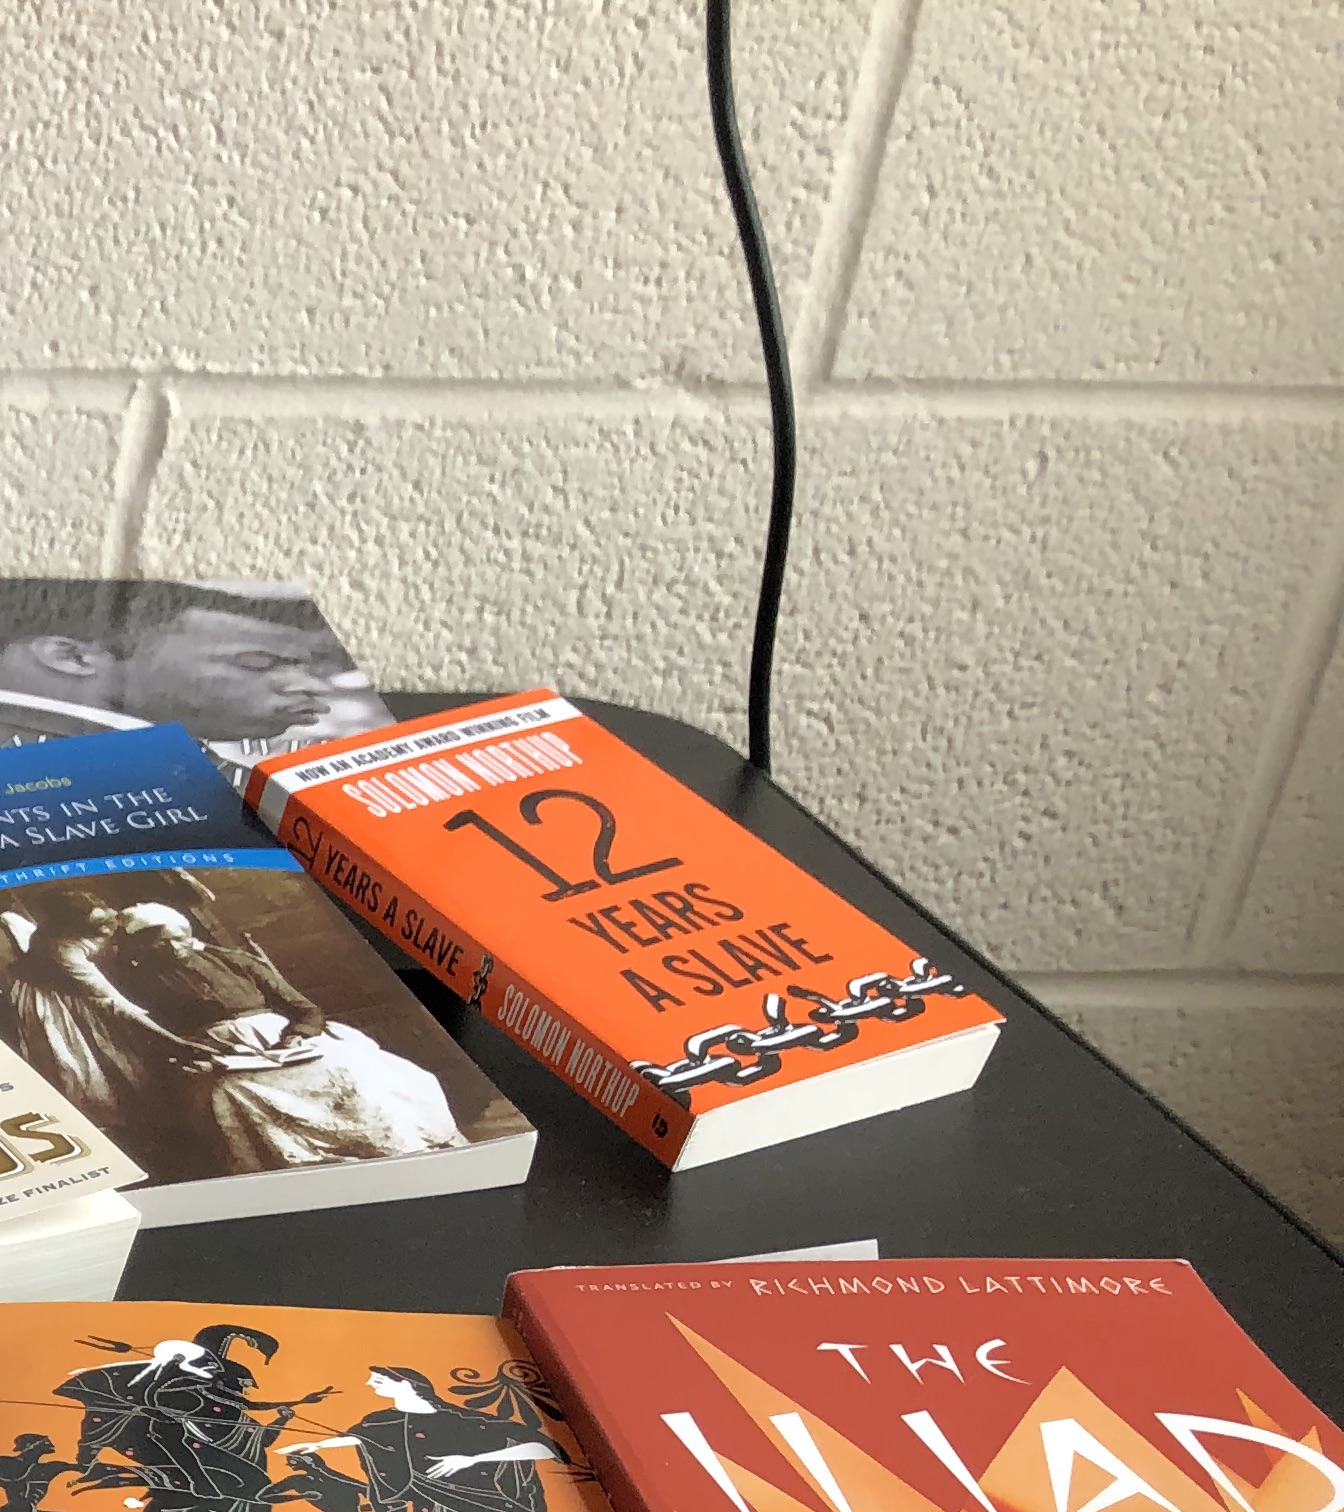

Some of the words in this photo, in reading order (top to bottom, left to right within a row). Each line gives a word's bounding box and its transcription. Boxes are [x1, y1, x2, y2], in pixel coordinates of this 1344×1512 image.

[5, 776, 73, 796] Jacobs
[342, 758, 482, 818] SOLOMON
[455, 731, 584, 787] NORTHUP
[26, 817, 121, 847] SLAVE
[126, 805, 209, 831] GIRL
[59, 796, 100, 819] IN
[103, 786, 174, 811] THE
[0, 861, 88, 885] THRIFT
[106, 851, 236, 870] EDITIONS
[443, 788, 685, 902] 12
[323, 842, 384, 913] YEARS
[381, 896, 401, 927] A
[401, 910, 465, 978] SLAVE
[567, 881, 746, 957] YEARS
[618, 967, 673, 1014] A
[653, 921, 834, 999] SLAVE
[496, 983, 571, 1067] SOLOMON
[566, 1038, 642, 1119] NORTHUP
[22, 1166, 113, 1199] FINALIST
[575, 1280, 704, 1293] TRANSLATED
[709, 1279, 735, 1291] BY
[749, 1274, 947, 1298] RICHMOND
[959, 1275, 1174, 1297] LATTIMORE
[816, 1338, 1033, 1387] THE
